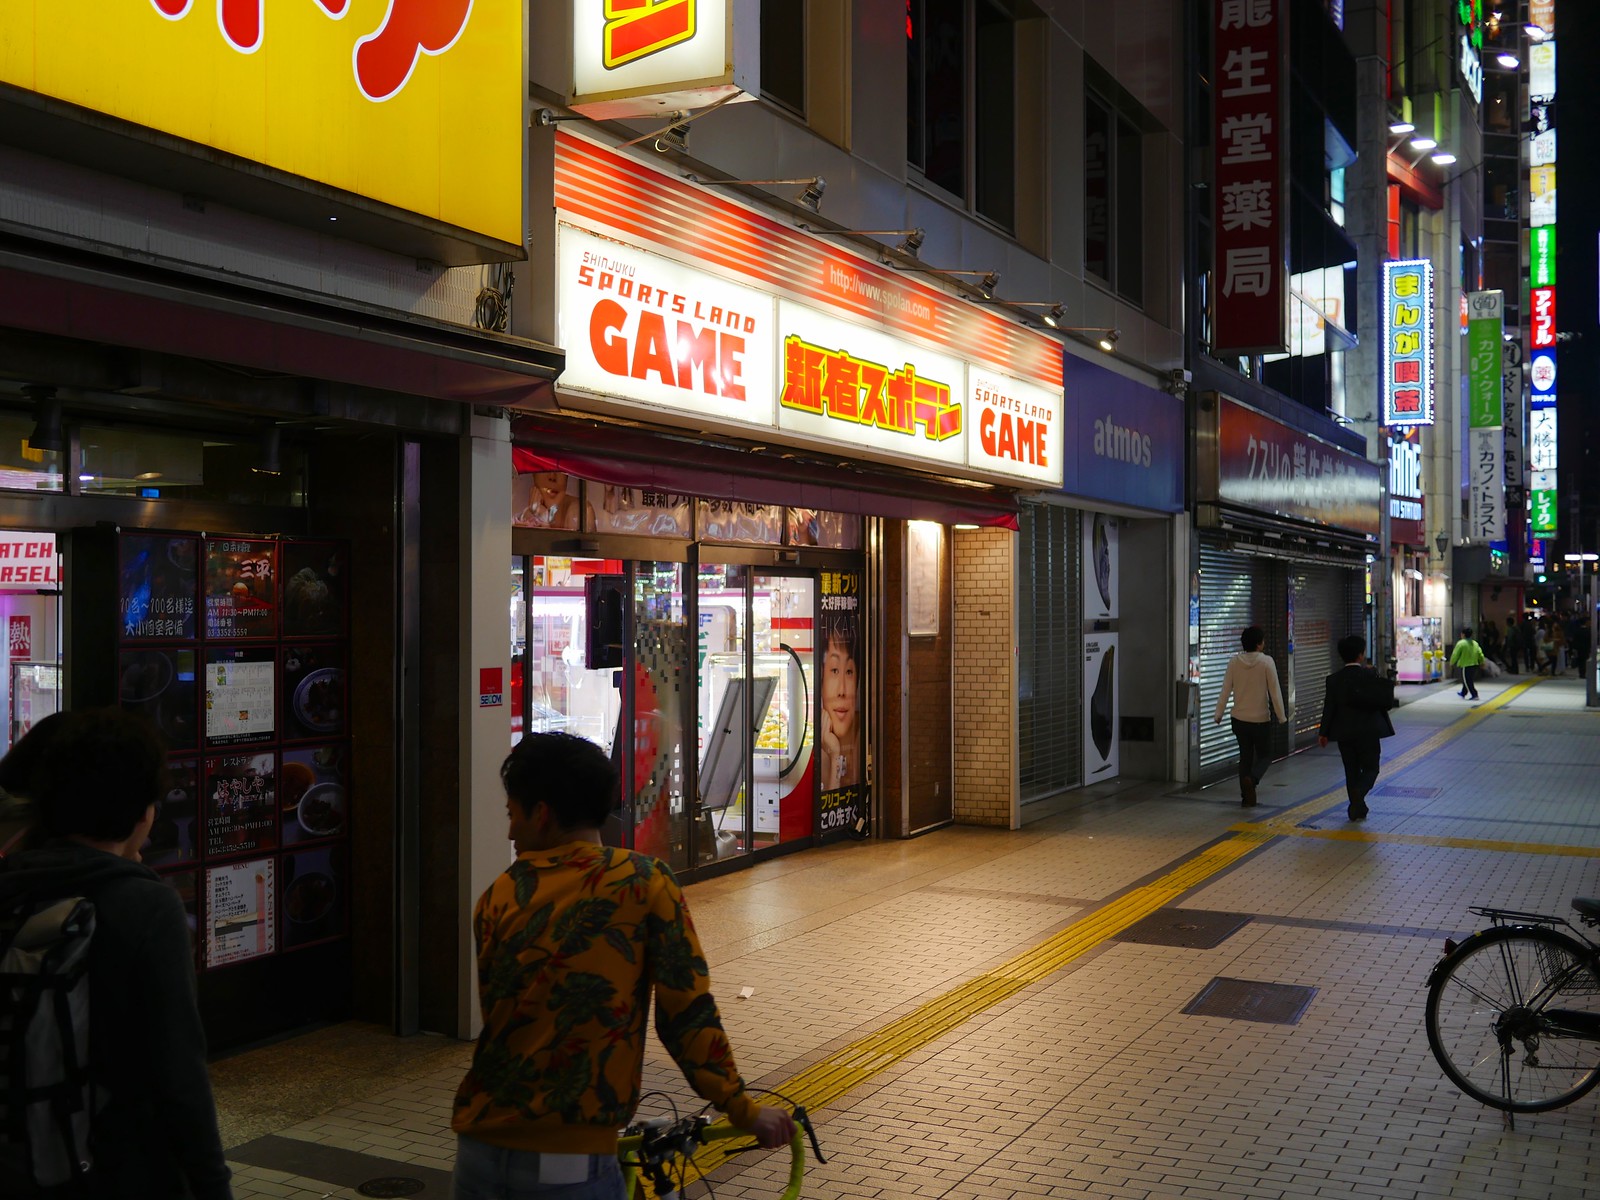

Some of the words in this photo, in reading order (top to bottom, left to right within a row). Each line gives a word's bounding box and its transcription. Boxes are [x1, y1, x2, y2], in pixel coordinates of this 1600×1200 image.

[583, 251, 636, 278] SHINJUKU
[578, 265, 686, 314] SPORTS
[694, 301, 756, 334] LAND
[829, 264, 931, 321] http://www.spolan.com
[1535, 290, 1553, 345] アイフル
[590, 298, 746, 402] GAME
[1393, 273, 1421, 415] まんが喫茶
[780, 334, 962, 441] 新宿スポラン
[975, 388, 1021, 413] SPORTS
[1024, 403, 1052, 421] LAND
[980, 407, 1048, 468] GAME
[1094, 413, 1151, 468] atmos
[1388, 438, 1422, 498] AME
[1480, 451, 1495, 537] カワノ・トラスト
[1537, 492, 1551, 525] レイク
[0, 543, 53, 558] ATCH
[0, 566, 64, 582] RSEL
[821, 572, 858, 594] 最新プリ
[10, 621, 31, 650] 熱
[480, 694, 502, 705] SECOM
[223, 755, 252, 767] レストラ
[821, 790, 858, 809] プリコーナー
[821, 805, 859, 830] この先すぐ
[232, 862, 249, 870] MENU
